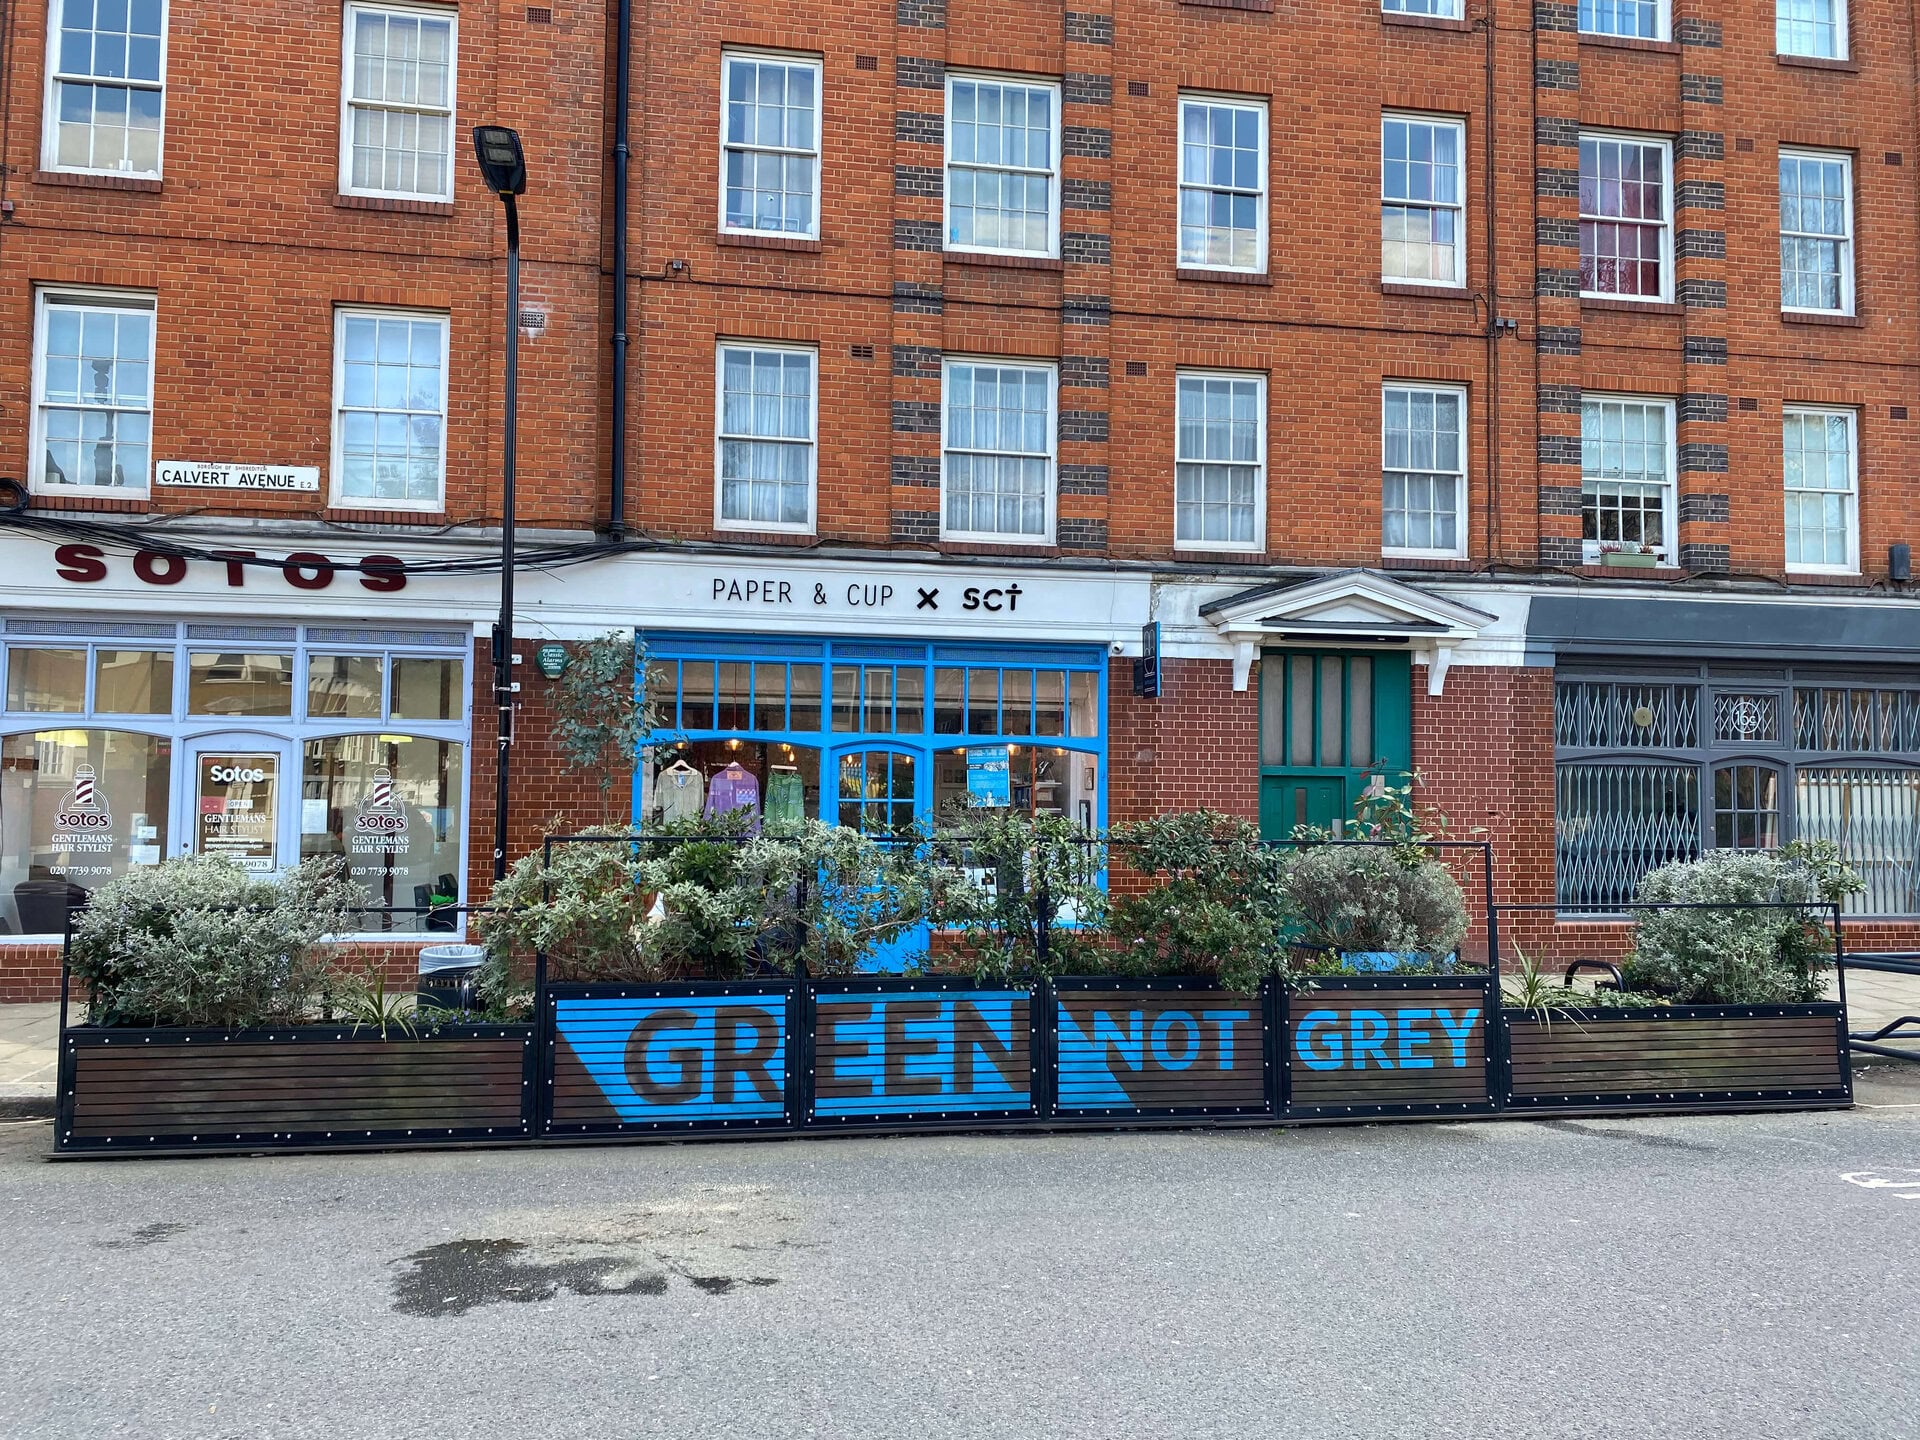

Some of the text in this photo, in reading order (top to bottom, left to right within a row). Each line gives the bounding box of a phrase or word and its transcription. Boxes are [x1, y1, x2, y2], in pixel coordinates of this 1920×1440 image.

[162, 470, 229, 485] CALVERT
[238, 473, 296, 488] AVENUE
[54, 543, 408, 592] SOTOS
[712, 578, 793, 604] PAPER
[812, 582, 828, 605] &
[847, 583, 894, 606] CUP
[210, 764, 264, 783] Sotos
[204, 813, 267, 823] GENTLEMANS
[205, 825, 264, 834] HAIR STYLIST
[51, 834, 113, 844] GENTLEMANS
[351, 835, 410, 845] GENTLEMANS
[51, 843, 113, 853] HAIR STYLIST
[351, 844, 410, 854] HAIR STYLIST
[49, 866, 112, 876] 020 7739 9078
[350, 866, 409, 876] 020 7739 9078
[624, 1001, 1481, 1103] GREEN NOT GREY
